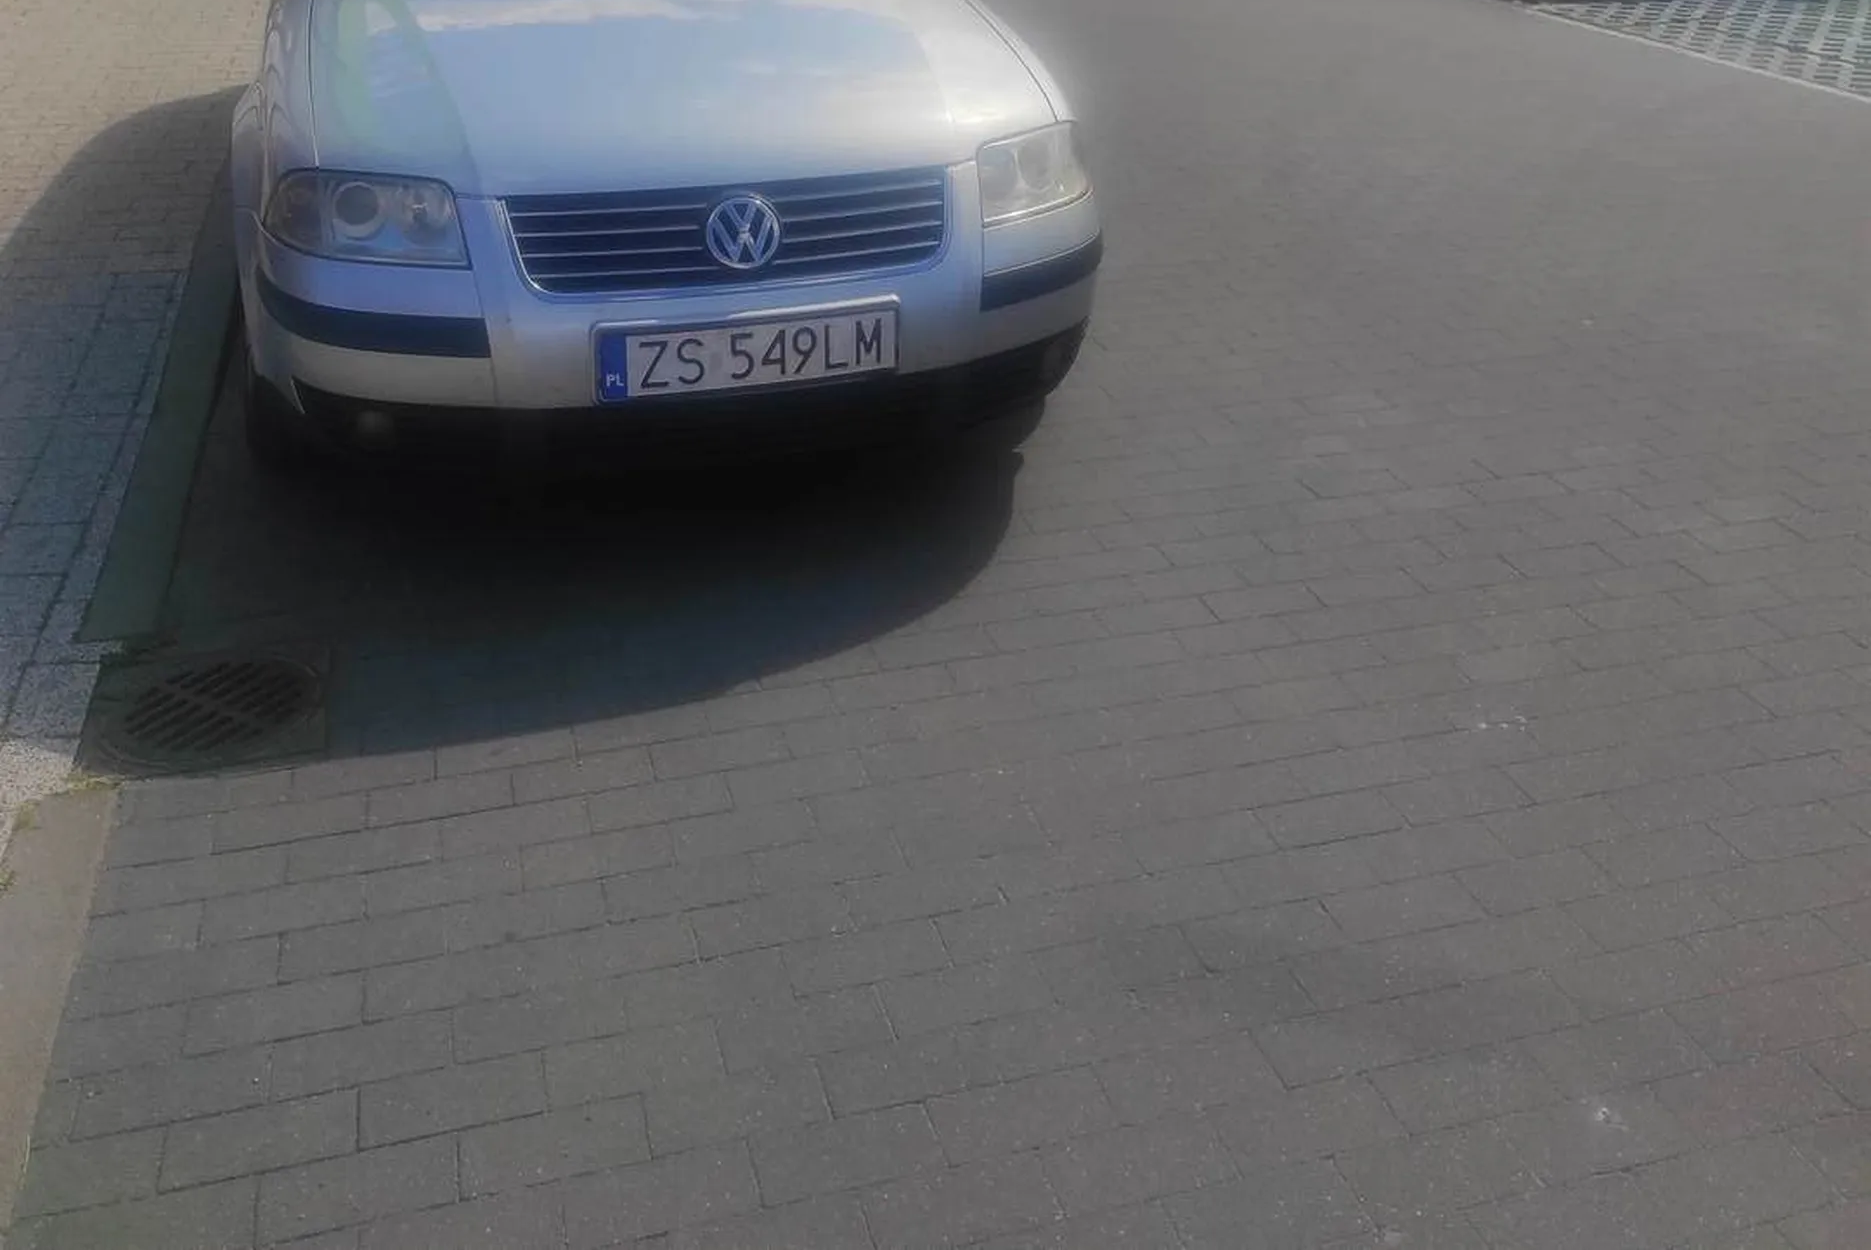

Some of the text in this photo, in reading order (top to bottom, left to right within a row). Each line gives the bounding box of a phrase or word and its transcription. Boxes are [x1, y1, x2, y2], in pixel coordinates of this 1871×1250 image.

[639, 318, 881, 389] ZS 549LM
[605, 374, 625, 387] PL
